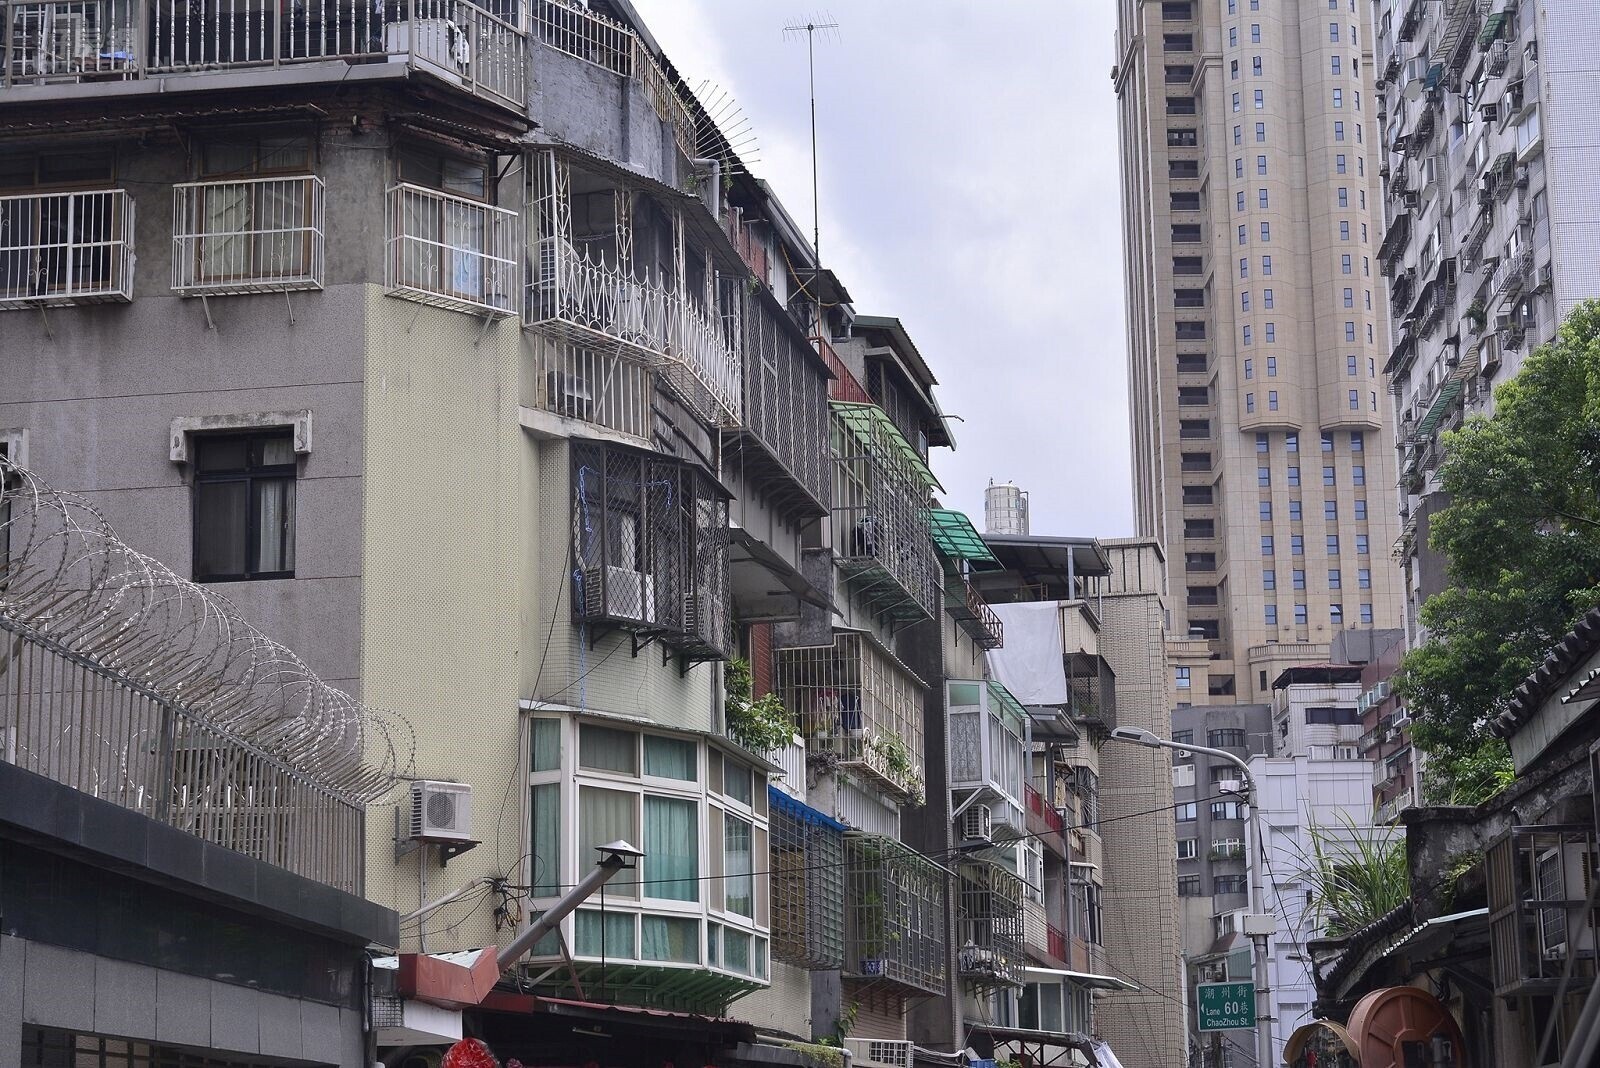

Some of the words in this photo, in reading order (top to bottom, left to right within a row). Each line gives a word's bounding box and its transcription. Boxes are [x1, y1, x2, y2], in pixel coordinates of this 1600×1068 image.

[1204, 986, 1247, 999] 潮州街
[1206, 1008, 1220, 1016] Lane
[1206, 1018, 1239, 1026] ChaoZhou
